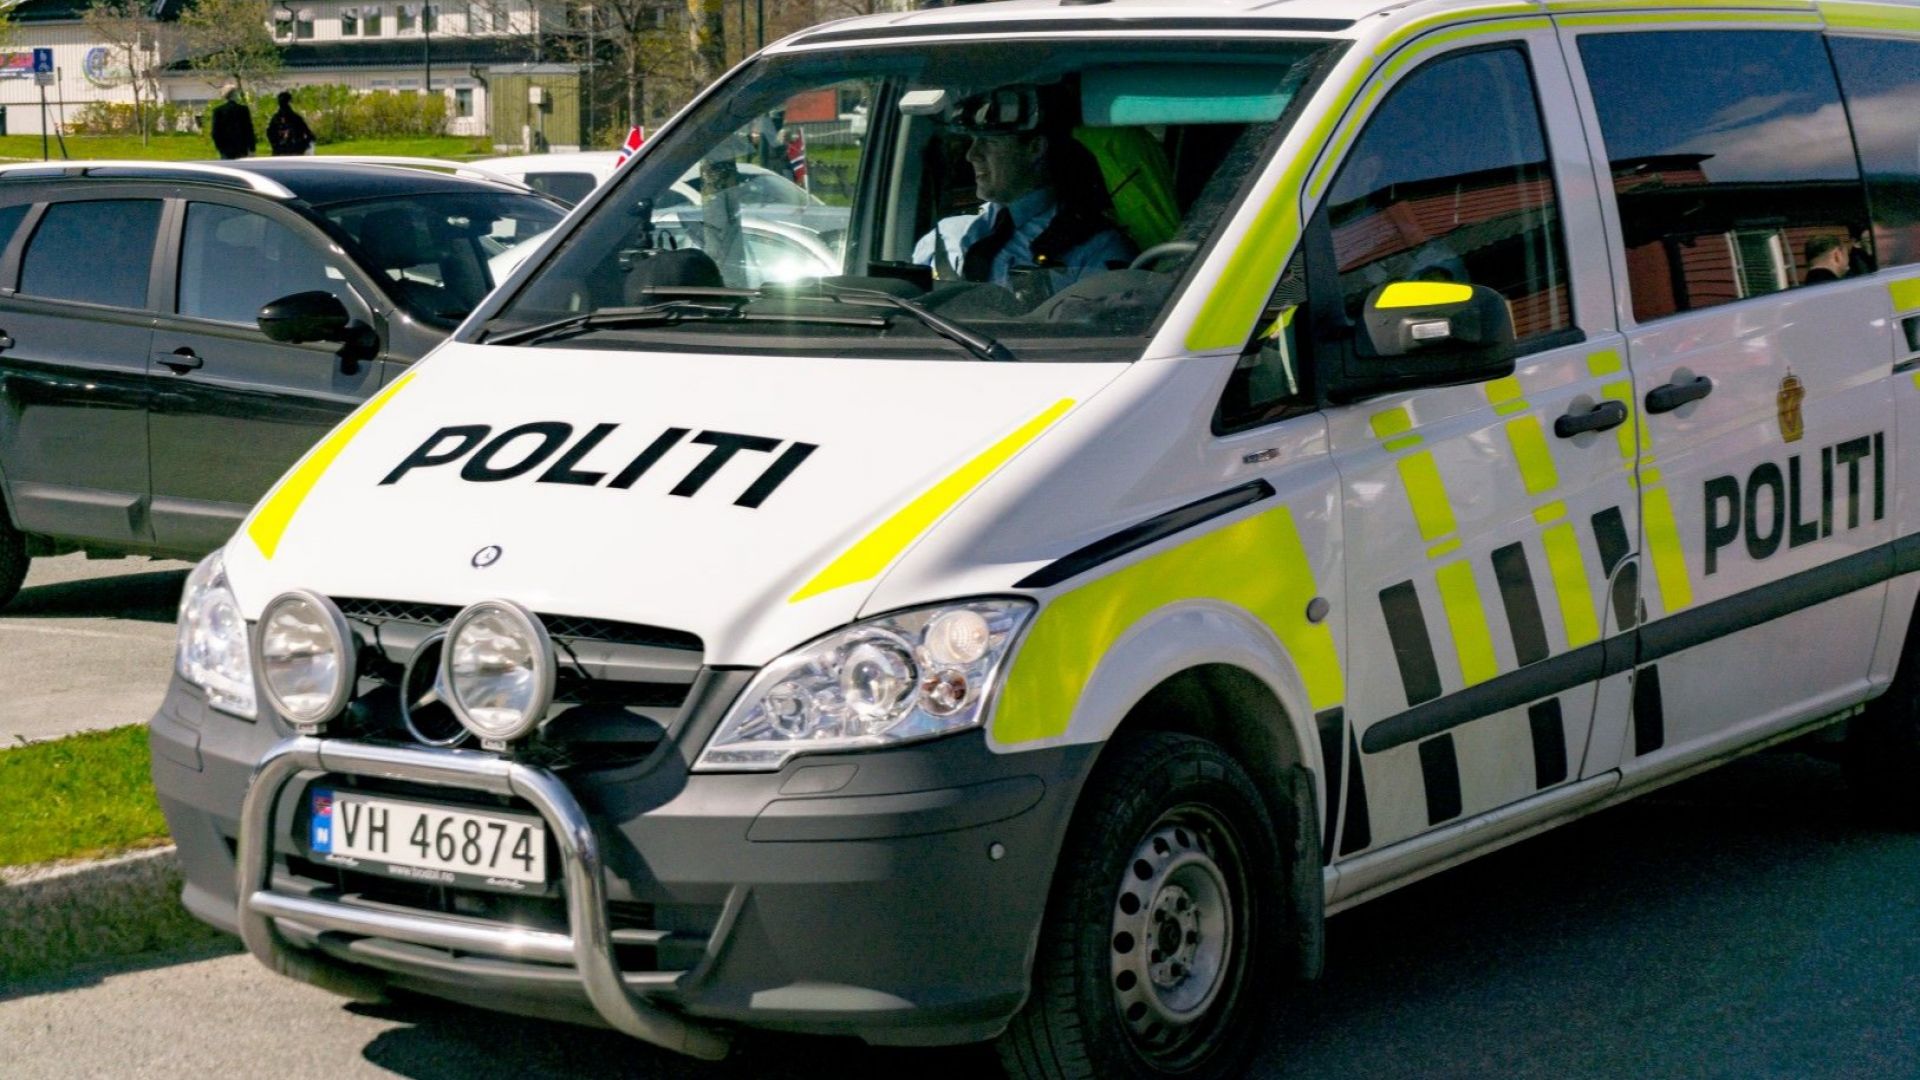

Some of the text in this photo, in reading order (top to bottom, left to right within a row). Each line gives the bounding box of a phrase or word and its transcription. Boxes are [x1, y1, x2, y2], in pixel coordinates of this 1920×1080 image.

[377, 421, 820, 509] POLITI
[1704, 431, 1885, 575] POLITI
[341, 800, 534, 872] VH 46874
